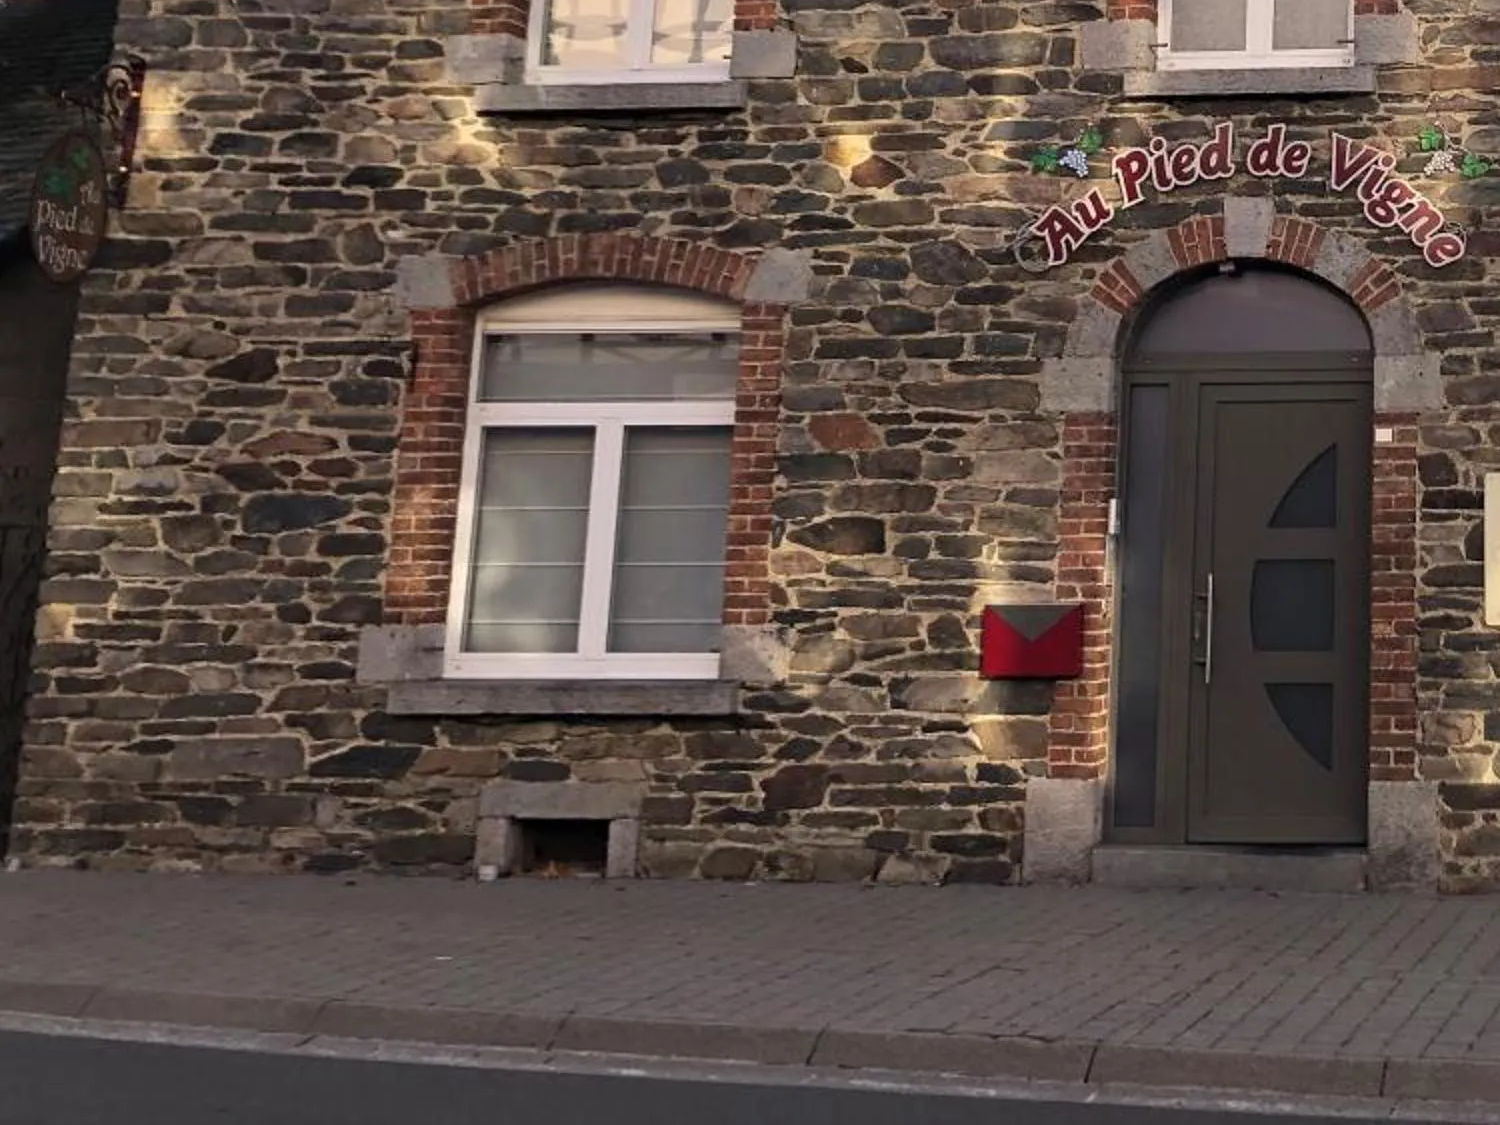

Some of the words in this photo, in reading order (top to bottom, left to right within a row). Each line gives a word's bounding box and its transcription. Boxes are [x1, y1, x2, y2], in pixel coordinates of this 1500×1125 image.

[1033, 188, 1114, 265] Au
[1112, 122, 1235, 209] Pied
[1247, 123, 1312, 177] de
[1331, 132, 1468, 267] Vigne
[34, 199, 78, 232] Pied
[38, 234, 89, 273] Vigne
